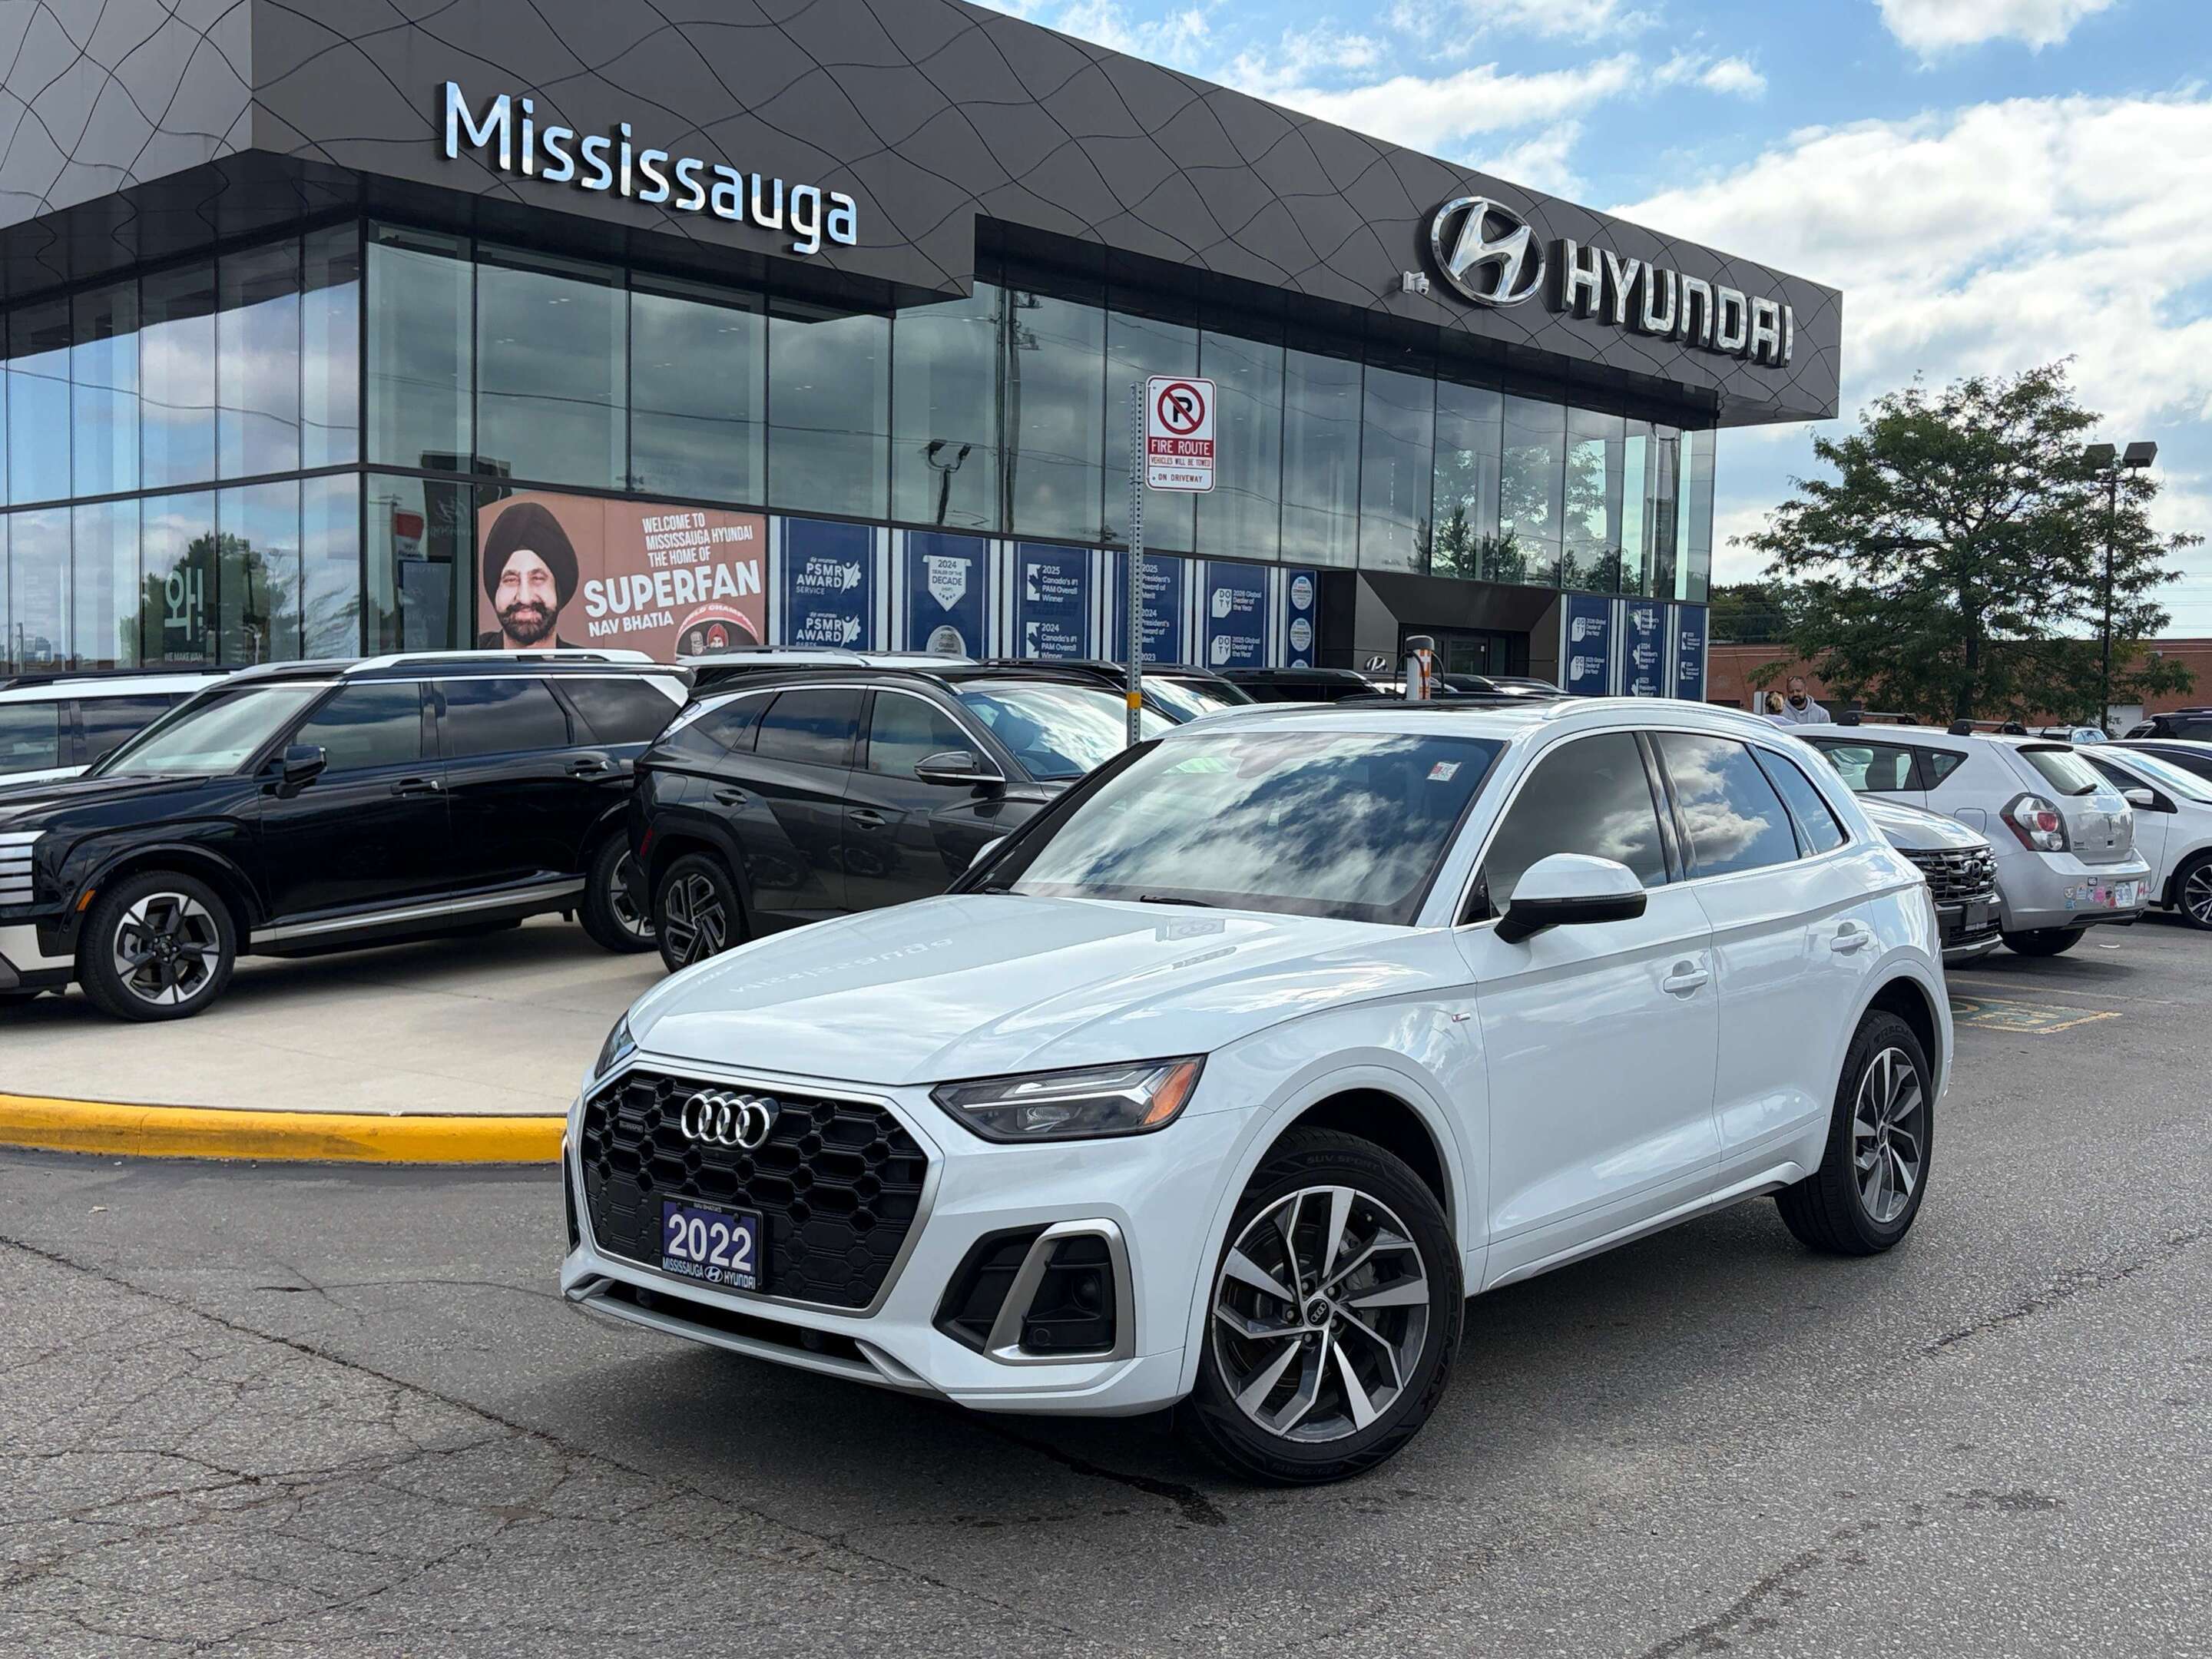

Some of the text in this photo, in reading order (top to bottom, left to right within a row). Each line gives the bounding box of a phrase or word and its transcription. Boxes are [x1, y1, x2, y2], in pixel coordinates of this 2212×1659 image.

[444, 79, 857, 255] Mississauga
[1557, 238, 1793, 367] HYUNDAI
[1151, 439, 1210, 455] FIRE ROUTE
[1151, 456, 1173, 465] VEHICLES
[643, 512, 706, 534] WELCOME TO
[646, 525, 753, 550] MISSISSAUGA HYUNDAI
[648, 546, 711, 568] THE HOME OF
[938, 560, 957, 568] 2024
[1142, 564, 1158, 573] 2025
[806, 562, 843, 577] PSMR
[1042, 565, 1061, 575] 2025
[796, 574, 842, 588] AWARD
[932, 576, 962, 586] DECADE
[1042, 575, 1071, 585] Canada's
[584, 559, 762, 618] SUPERFAN
[796, 586, 826, 595] SERVICE
[1057, 586, 1078, 594] Overall
[1042, 594, 1064, 602] Winner
[1219, 590, 1230, 598] DO
[164, 567, 203, 641] 와!
[1142, 608, 1157, 618] 2024
[588, 611, 674, 637] NAV BHATIA
[806, 618, 842, 631] PSMR
[1041, 623, 1059, 632] 2024
[796, 629, 842, 642] AWARD
[1041, 634, 1070, 642] Canada's
[1218, 637, 1230, 645] DO
[1218, 646, 1229, 654] TY
[164, 652, 174, 662] WE
[174, 651, 189, 662] MAKE
[1141, 653, 1156, 661] 2023
[1306, 1154, 1334, 1164] SUV
[668, 1214, 752, 1272] 2022
[662, 1257, 756, 1290] MISSISSAUGA HYUNDAI
